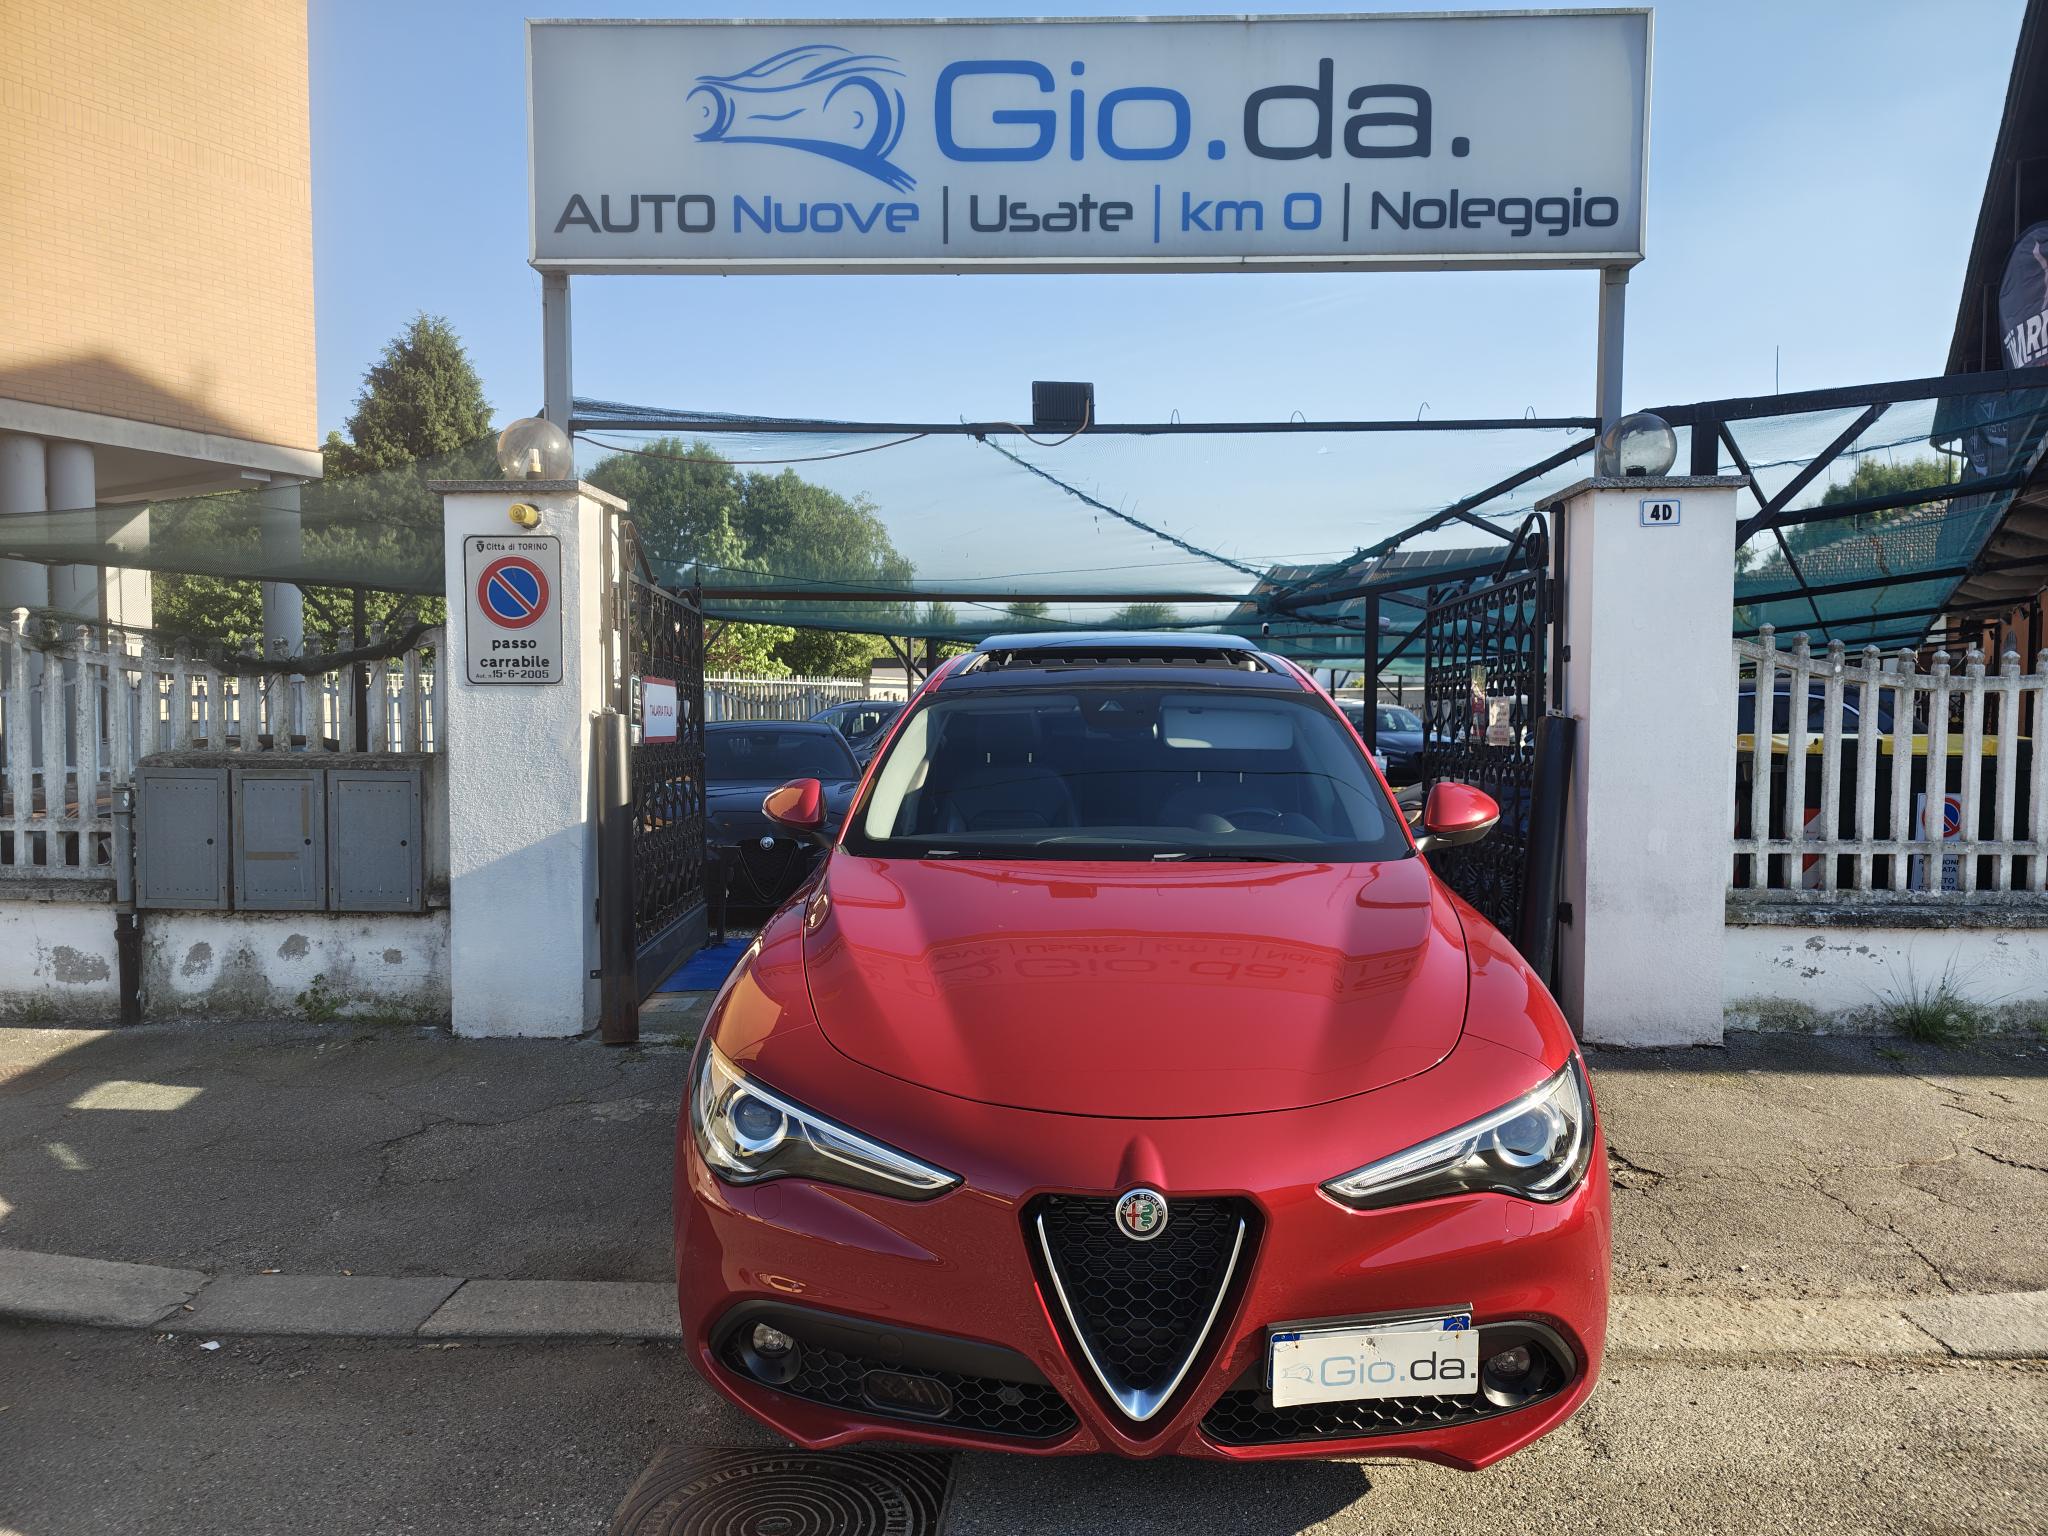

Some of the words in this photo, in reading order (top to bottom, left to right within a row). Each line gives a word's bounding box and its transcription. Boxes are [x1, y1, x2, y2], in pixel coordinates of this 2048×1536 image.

[553, 193, 716, 234] AUTO
[733, 194, 919, 234] Nuove
[970, 192, 1133, 234] Usate
[1181, 191, 1263, 232] km
[1371, 187, 1619, 237] Noleggio
[1650, 504, 1673, 521] 4D
[508, 542, 515, 551] di
[518, 543, 548, 551] TORINO
[492, 639, 537, 651] passo
[480, 655, 550, 668] carrabile
[492, 669, 549, 679] 15-6-2005
[1121, 1196, 1136, 1216] ALFA
[1139, 1194, 1163, 1217] ROMEO
